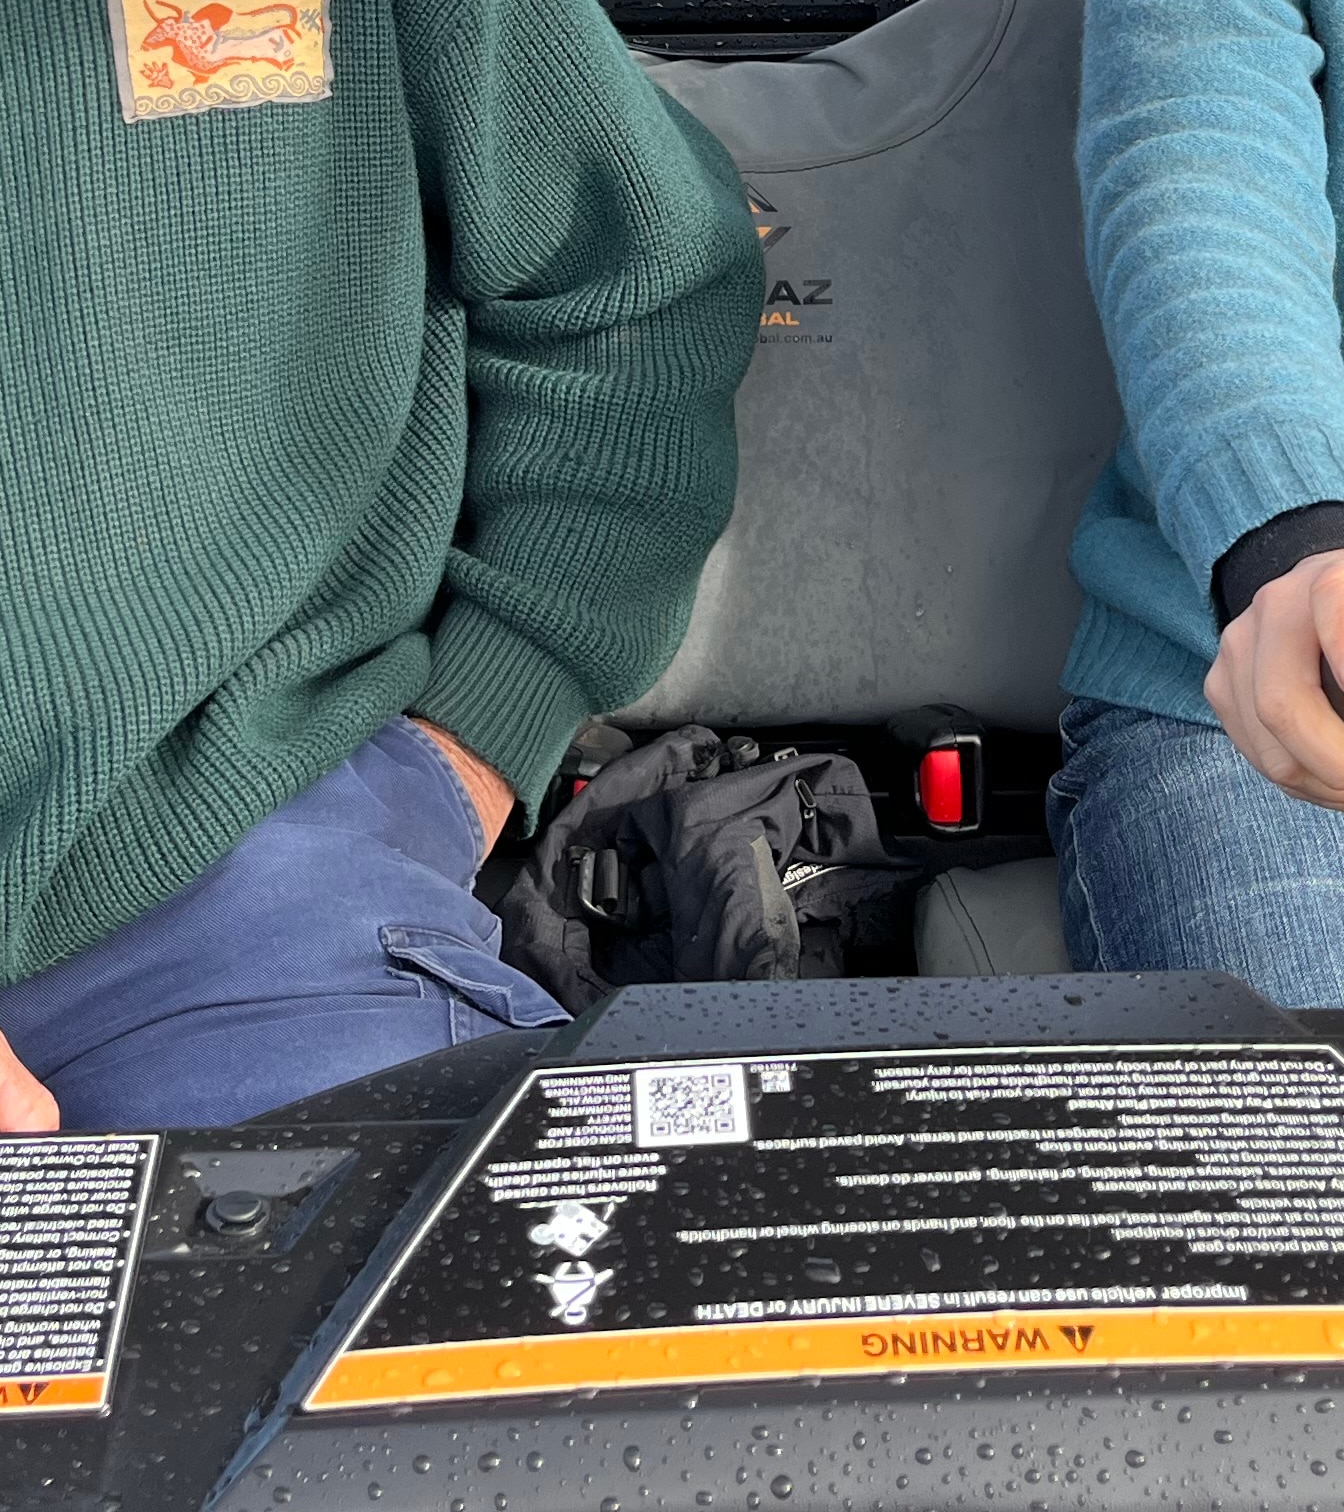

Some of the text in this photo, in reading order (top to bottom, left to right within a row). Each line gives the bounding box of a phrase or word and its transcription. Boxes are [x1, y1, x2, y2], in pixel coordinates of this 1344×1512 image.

[766, 279, 833, 305] AZ
[759, 333, 833, 344] bal.com.au
[1067, 1098, 1115, 1111] Ahead
[1115, 1098, 1151, 1110] Plan
[1148, 1098, 1179, 1110] and
[1177, 1097, 1244, 1109] Attention
[1244, 1096, 1275, 1109] Pay
[1273, 1097, 1322, 1109] Riders
[1035, 1141, 1073, 1153] stop.
[1072, 1141, 1083, 1152] a
[1083, 1140, 1119, 1153] from
[1118, 1140, 1154, 1151] even
[1153, 1139, 1210, 1152] turning,
[1209, 1139, 1250, 1151] when
[1249, 1139, 1336, 1151] acceleration
[487, 1152, 660, 1174] even on flat, open areas.
[560, 1167, 617, 1183] injuries
[616, 1164, 667, 1178] severe
[530, 1171, 562, 1187] and
[490, 1179, 657, 1202] Rollovers have caused
[1225, 1239, 1300, 1254] protective
[1299, 1239, 1330, 1254] and
[11, 1260, 66, 1274] attempt
[67, 1257, 95, 1272] not
[93, 1256, 115, 1272] Do
[694, 1283, 1247, 1320] Improper vehicle use can result in SEVERE INJURY or DEATH
[3, 1320, 60, 1335] working
[62, 1319, 101, 1333] when
[15, 1334, 46, 1349] and
[48, 1332, 98, 1345] flames,
[861, 1326, 1051, 1357] WARNING
[7, 1349, 32, 1363] are
[33, 1345, 96, 1361] batteries
[23, 1358, 93, 1375] Explosive
